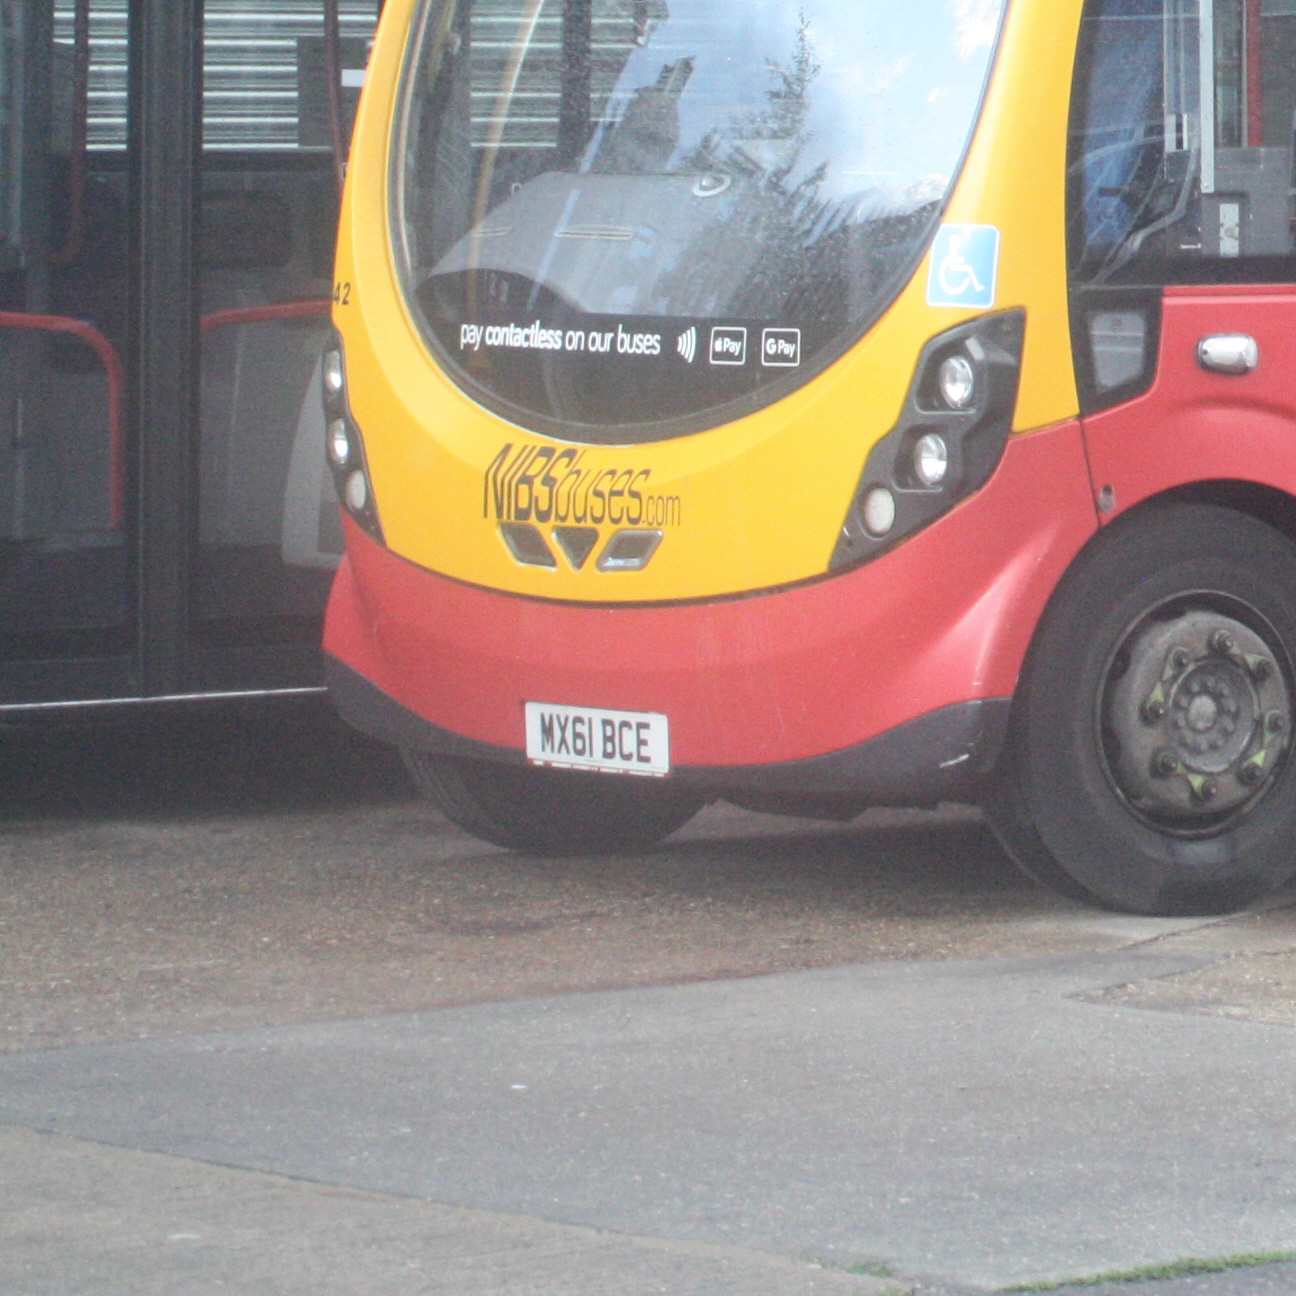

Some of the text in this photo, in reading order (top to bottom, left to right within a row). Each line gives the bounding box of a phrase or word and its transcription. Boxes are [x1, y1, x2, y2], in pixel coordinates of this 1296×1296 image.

[460, 320, 661, 355] pay contactless on our buses
[723, 337, 742, 356] Pay
[766, 338, 796, 358] G Pay
[483, 443, 681, 526] NIBSbuses.com
[540, 712, 651, 763] MX61 BCE
